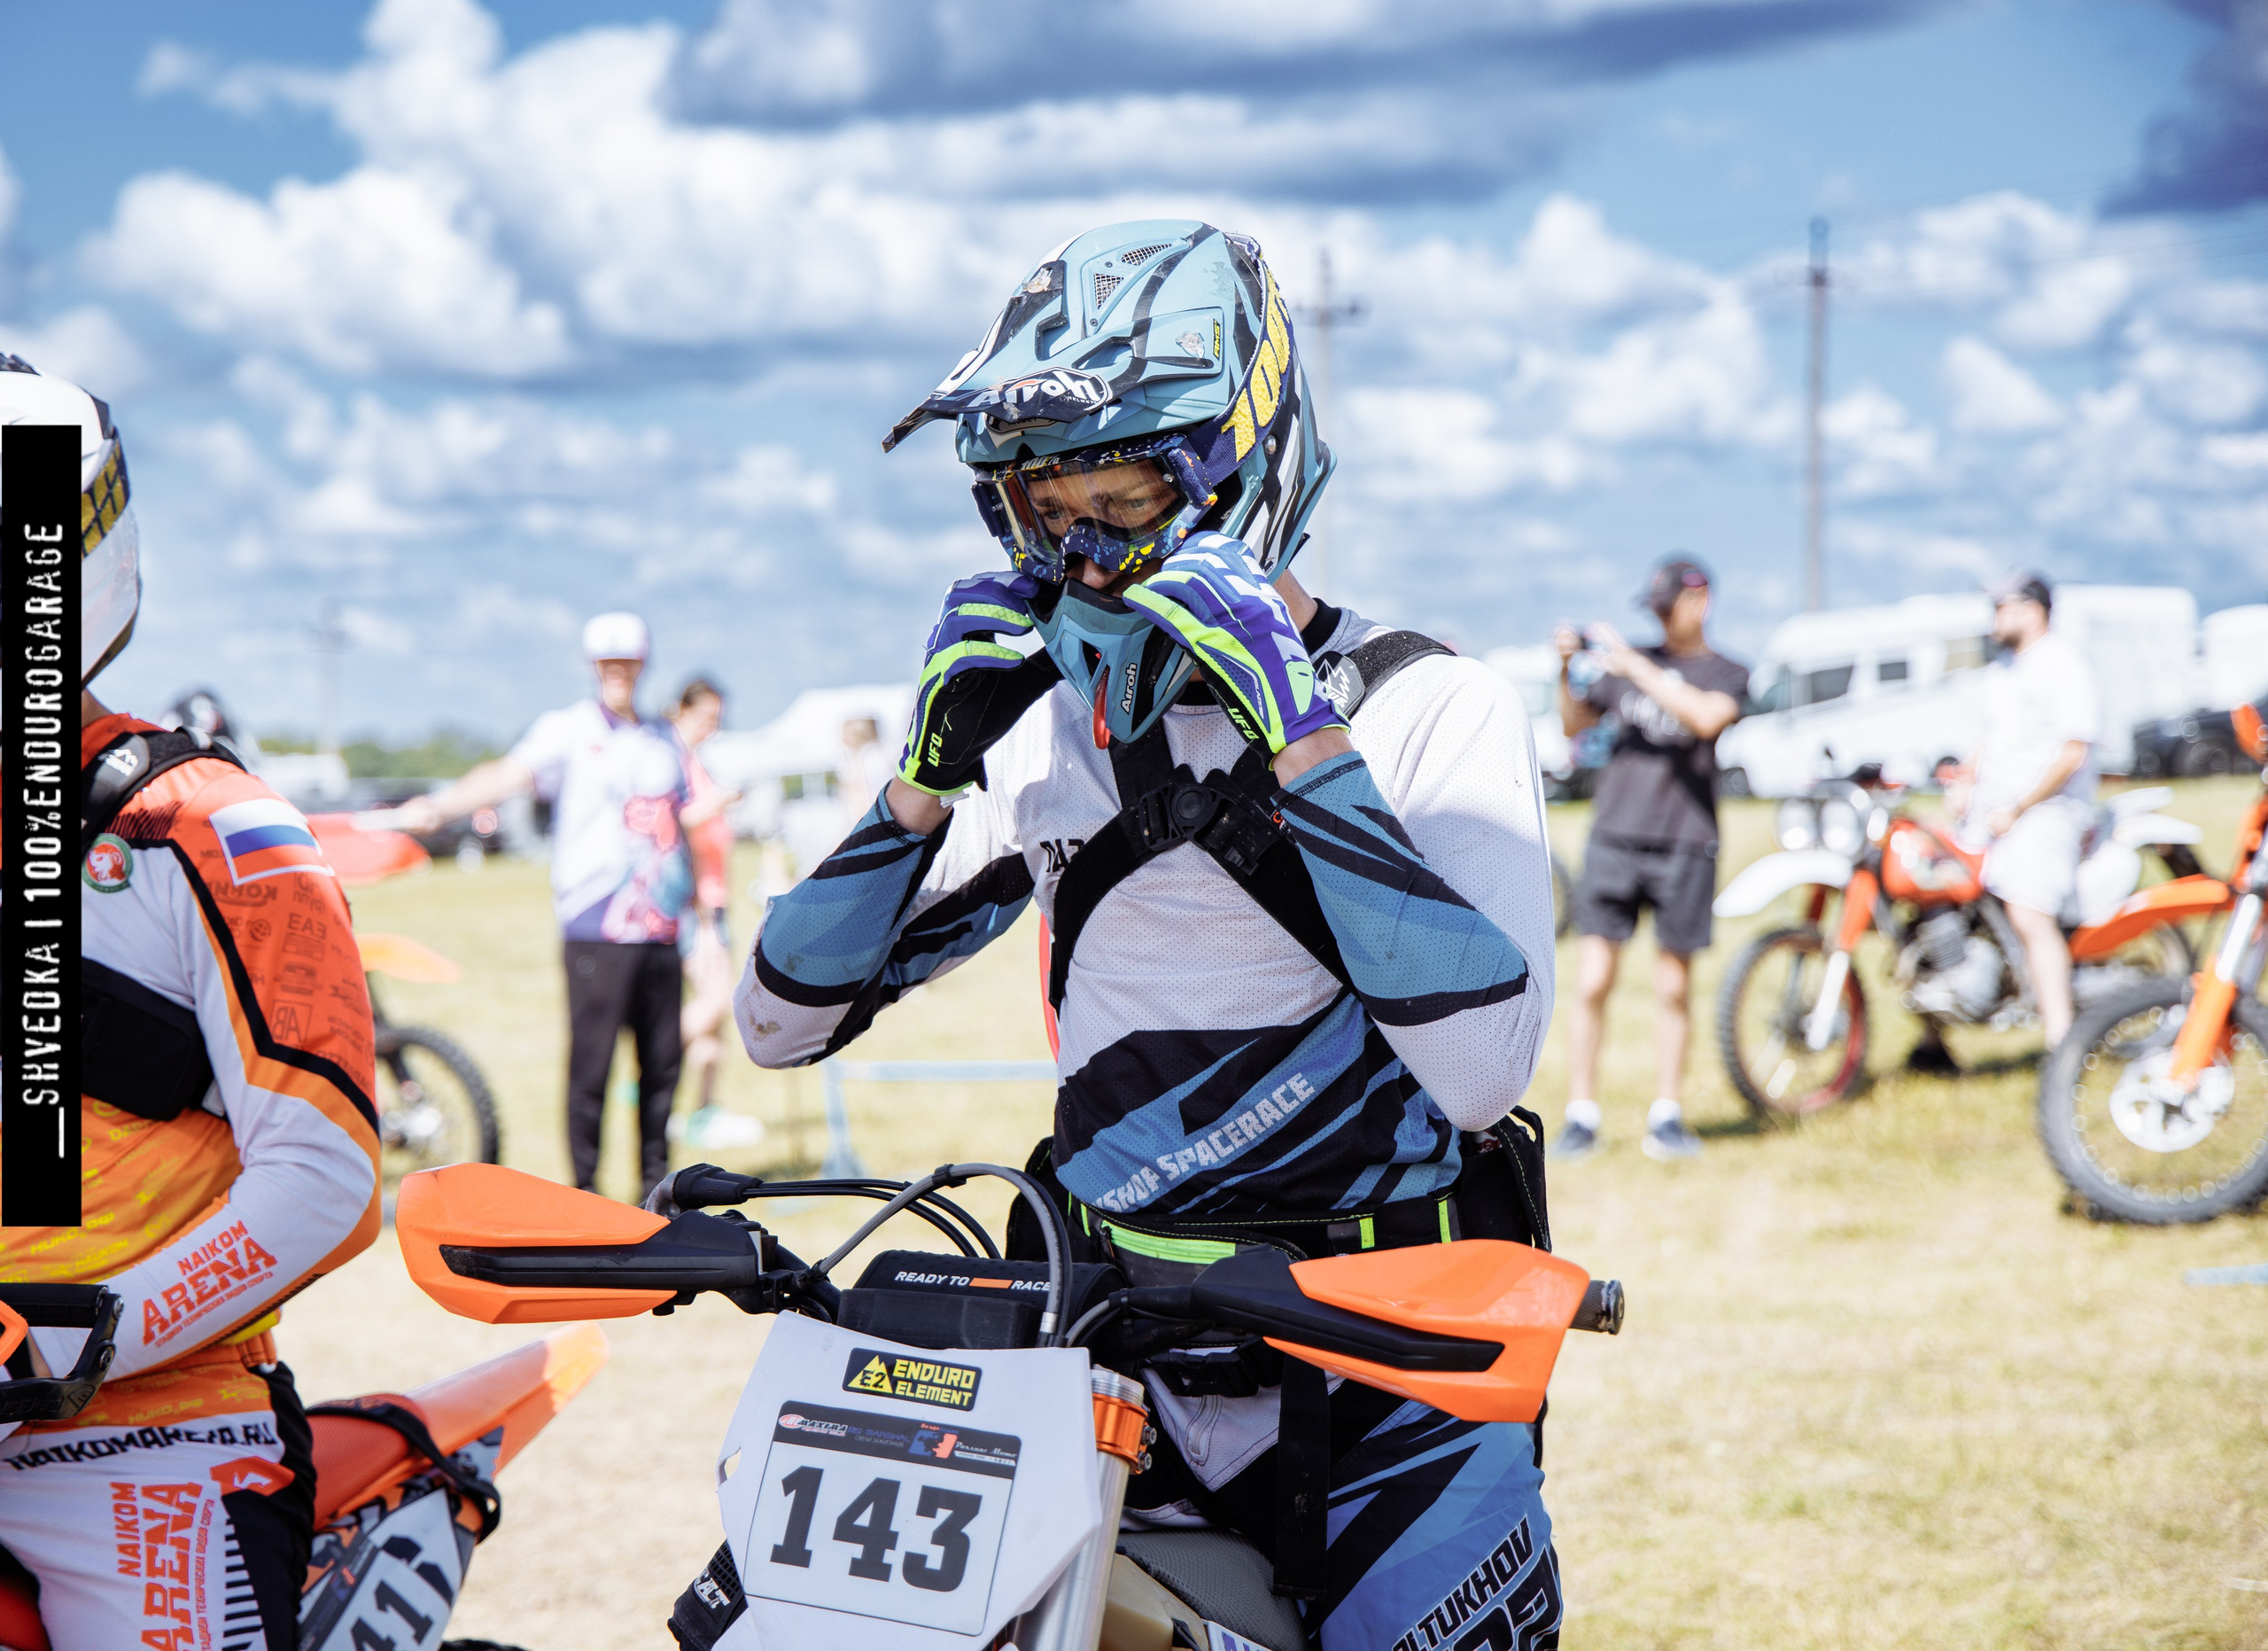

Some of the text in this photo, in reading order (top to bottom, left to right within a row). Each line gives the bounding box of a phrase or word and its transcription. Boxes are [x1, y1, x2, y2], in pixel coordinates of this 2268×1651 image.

[967, 370, 1100, 408] Airoh
[1120, 661, 1138, 715] Airoh
[1227, 707, 1259, 740] UFO
[927, 732, 943, 767] UFO
[1156, 1072, 1316, 1180] SPACERACE
[177, 1220, 249, 1277] NAIKOM
[142, 1237, 278, 1347] ARENA
[894, 1271, 1052, 1291] READY TO RACE
[892, 1359, 976, 1390] ENDURO
[894, 1381, 973, 1406] ELEMENT
[796, 1419, 849, 1434] MAXIMA
[109, 1482, 141, 1577] NAIKOM
[769, 1465, 983, 1593] 143
